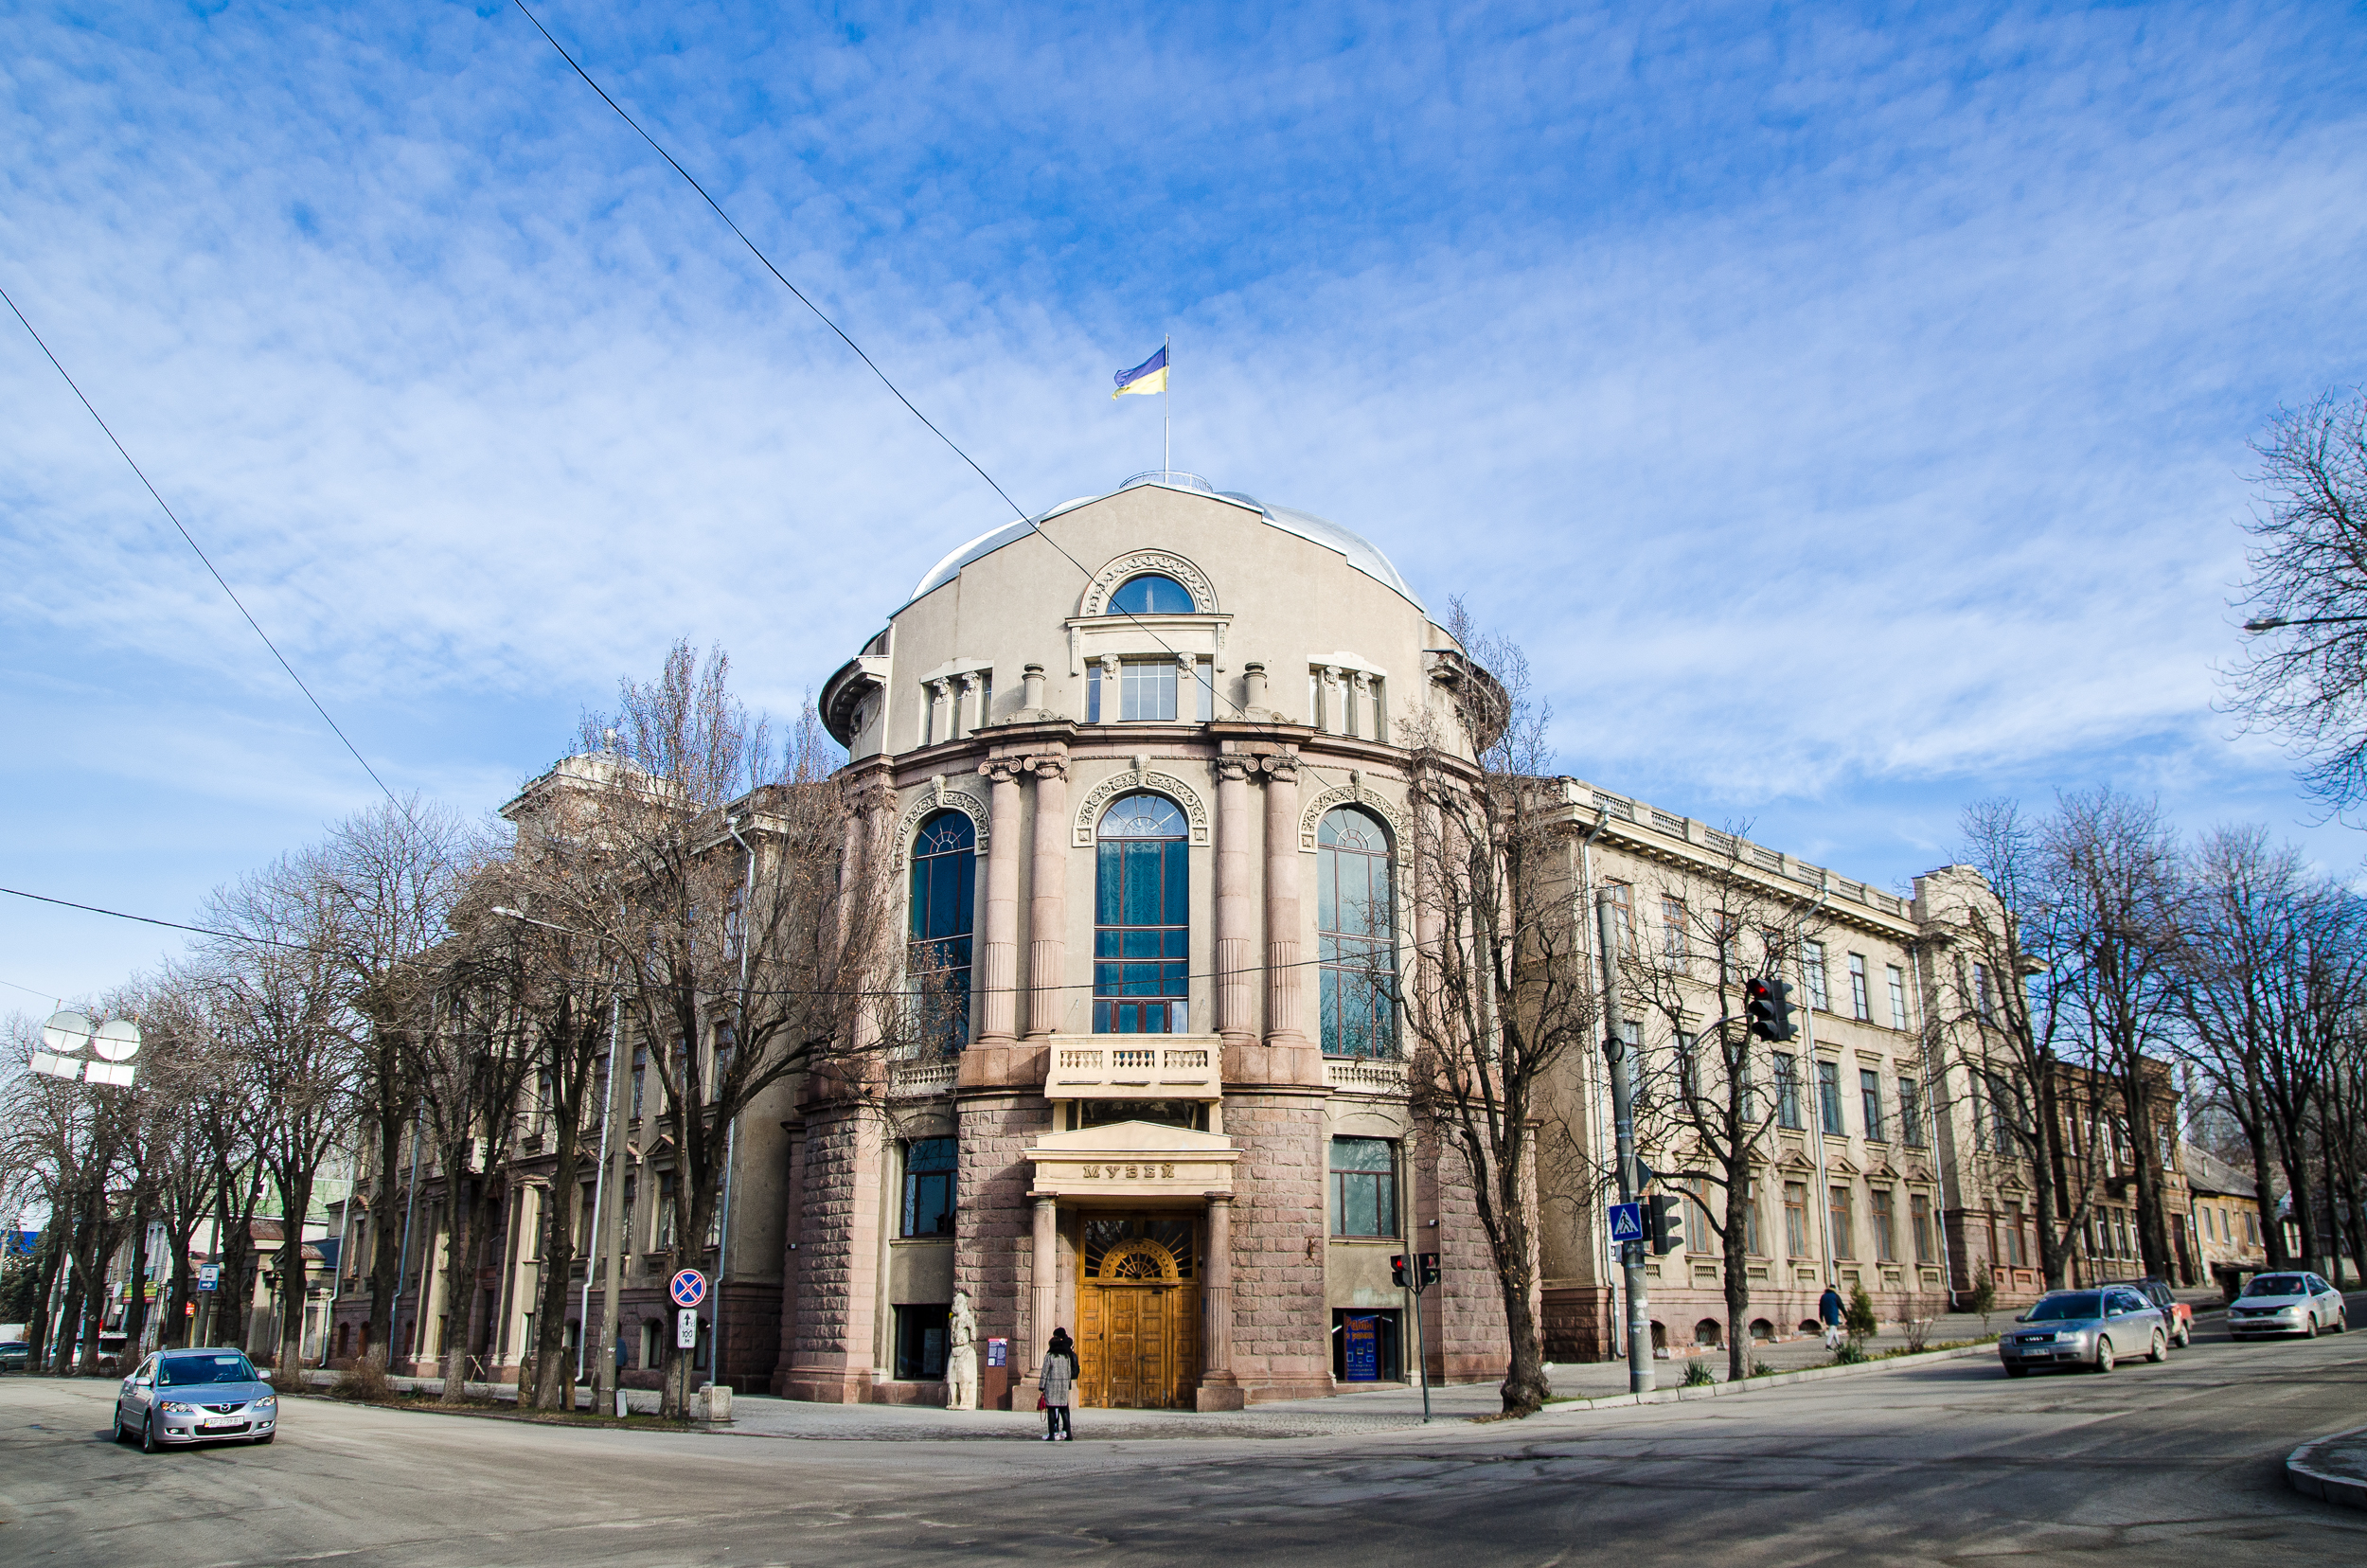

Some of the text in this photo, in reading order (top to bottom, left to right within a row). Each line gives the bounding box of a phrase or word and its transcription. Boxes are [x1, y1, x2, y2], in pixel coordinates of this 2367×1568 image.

[1083, 1163, 1174, 1179] МУЗЕЙ
[1345, 1316, 1374, 1330] Рамы
[682, 1329, 693, 1338] 100
